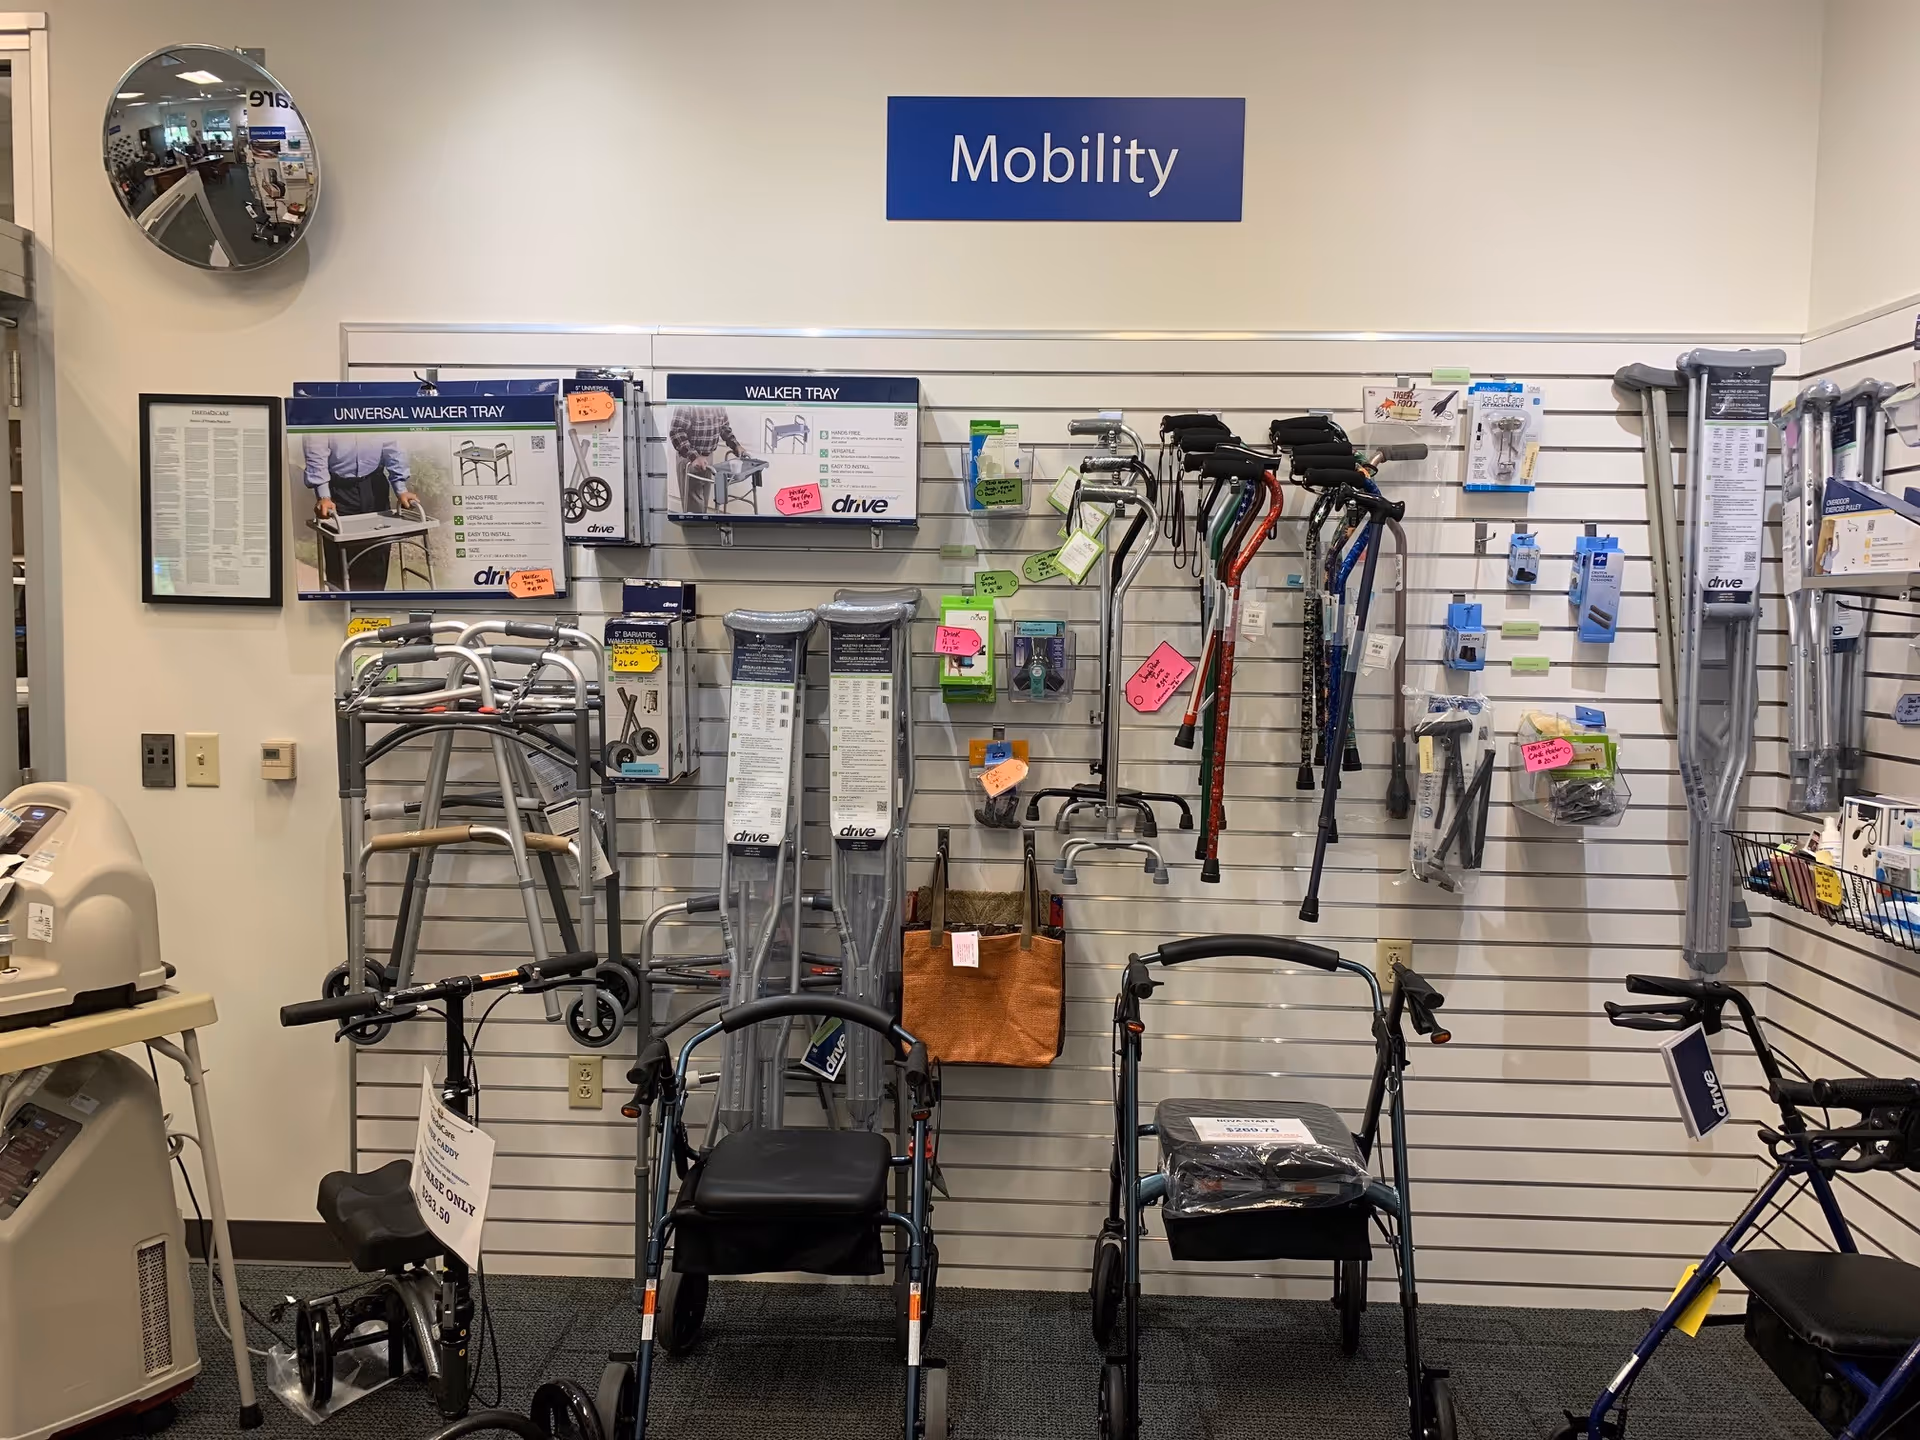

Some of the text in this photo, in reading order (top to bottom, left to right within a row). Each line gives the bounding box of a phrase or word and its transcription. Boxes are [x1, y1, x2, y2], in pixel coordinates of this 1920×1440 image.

[950, 132, 1180, 198] Mobility
[745, 386, 840, 400] WALKER TRAY
[1393, 391, 1414, 400] TIGER
[1397, 400, 1419, 408] FOOT
[334, 405, 505, 421] UNIVERSAL WALKER TRAY
[831, 494, 889, 513] drive
[587, 523, 615, 534] drive
[1707, 575, 1744, 590] drive
[622, 631, 657, 639] BARIATRIC
[942, 629, 961, 638] Drink
[552, 780, 569, 792] drive
[733, 829, 770, 843] drive
[839, 824, 877, 837] drive
[825, 1033, 846, 1073] drive
[1703, 1069, 1727, 1117] drive
[437, 1137, 460, 1160] CADDY
[421, 1184, 451, 1225] $283.50
[445, 1189, 476, 1217] ONLY
